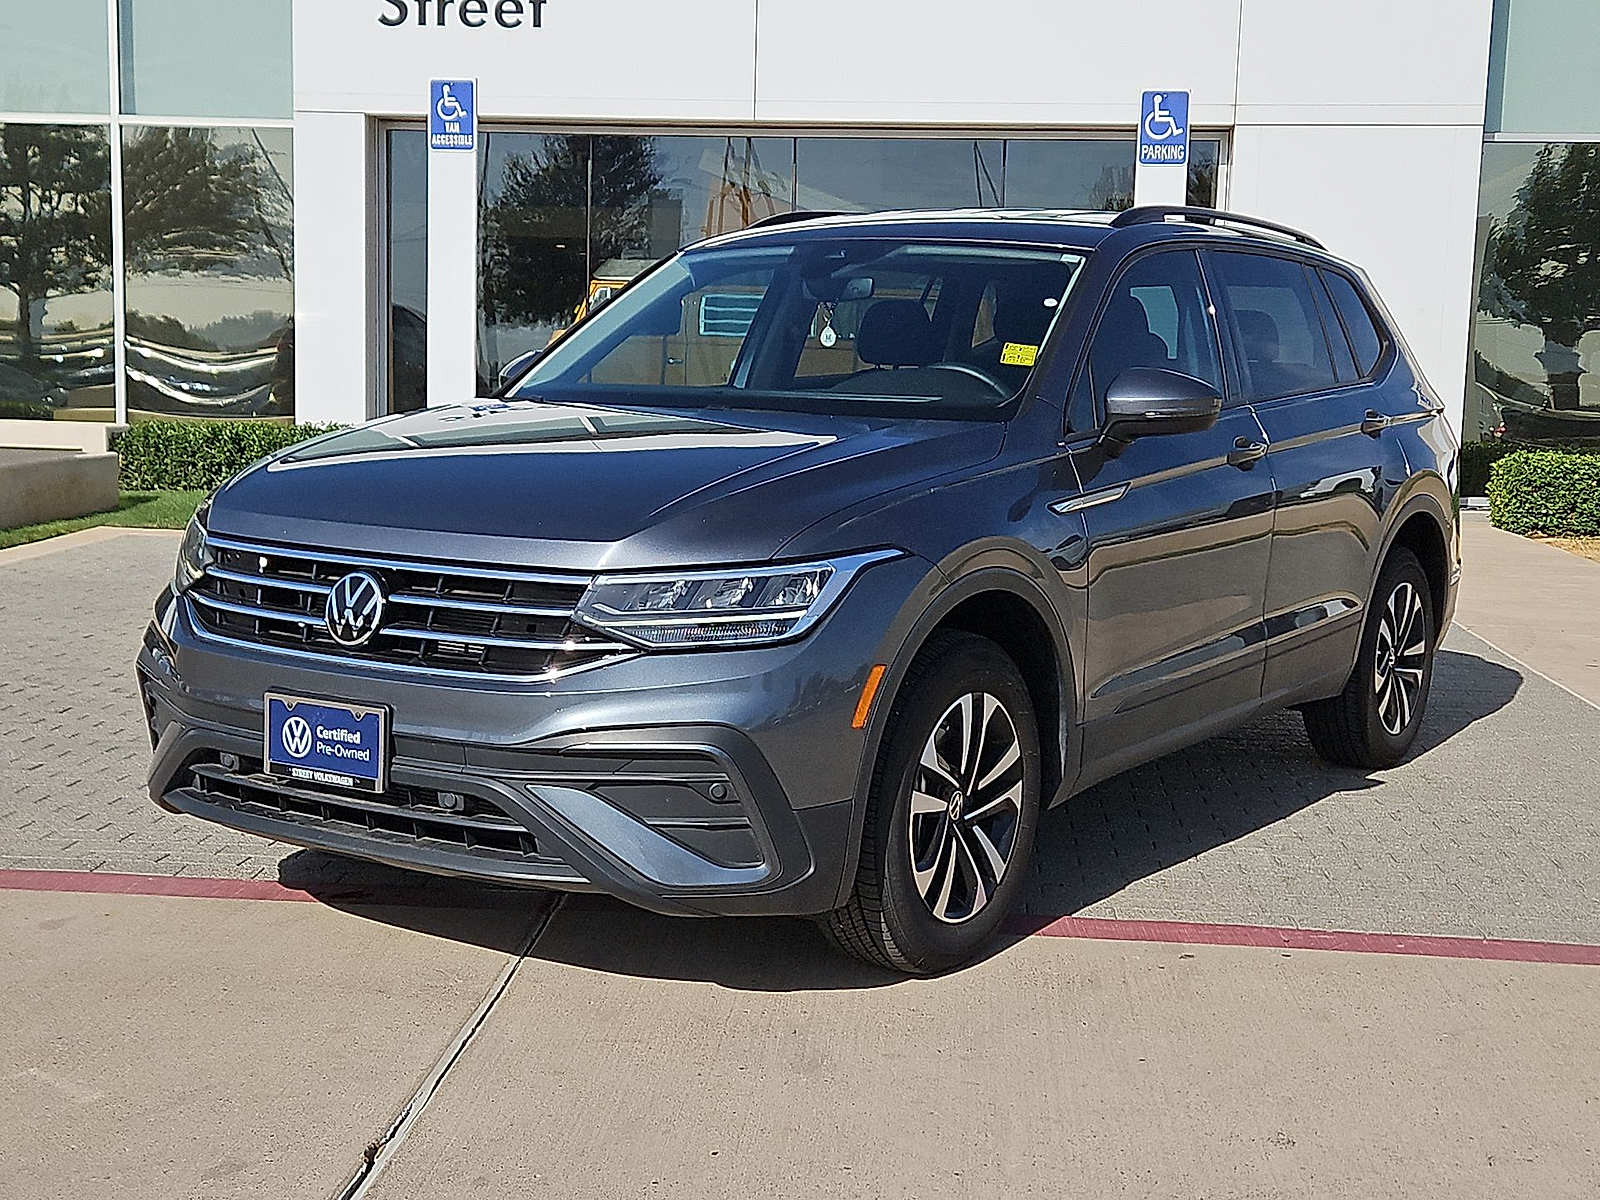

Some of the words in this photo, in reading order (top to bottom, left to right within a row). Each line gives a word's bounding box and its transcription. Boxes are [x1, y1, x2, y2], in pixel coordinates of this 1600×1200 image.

[378, 0, 547, 28] Street
[444, 121, 460, 133] VAN
[431, 133, 473, 146] ACCESSIBLE
[1140, 144, 1185, 161] PARKING
[316, 725, 361, 744] Certified
[316, 741, 370, 761] Pre-Owned
[292, 767, 314, 780] STREET
[313, 770, 354, 787] VOLKSWAGEN
